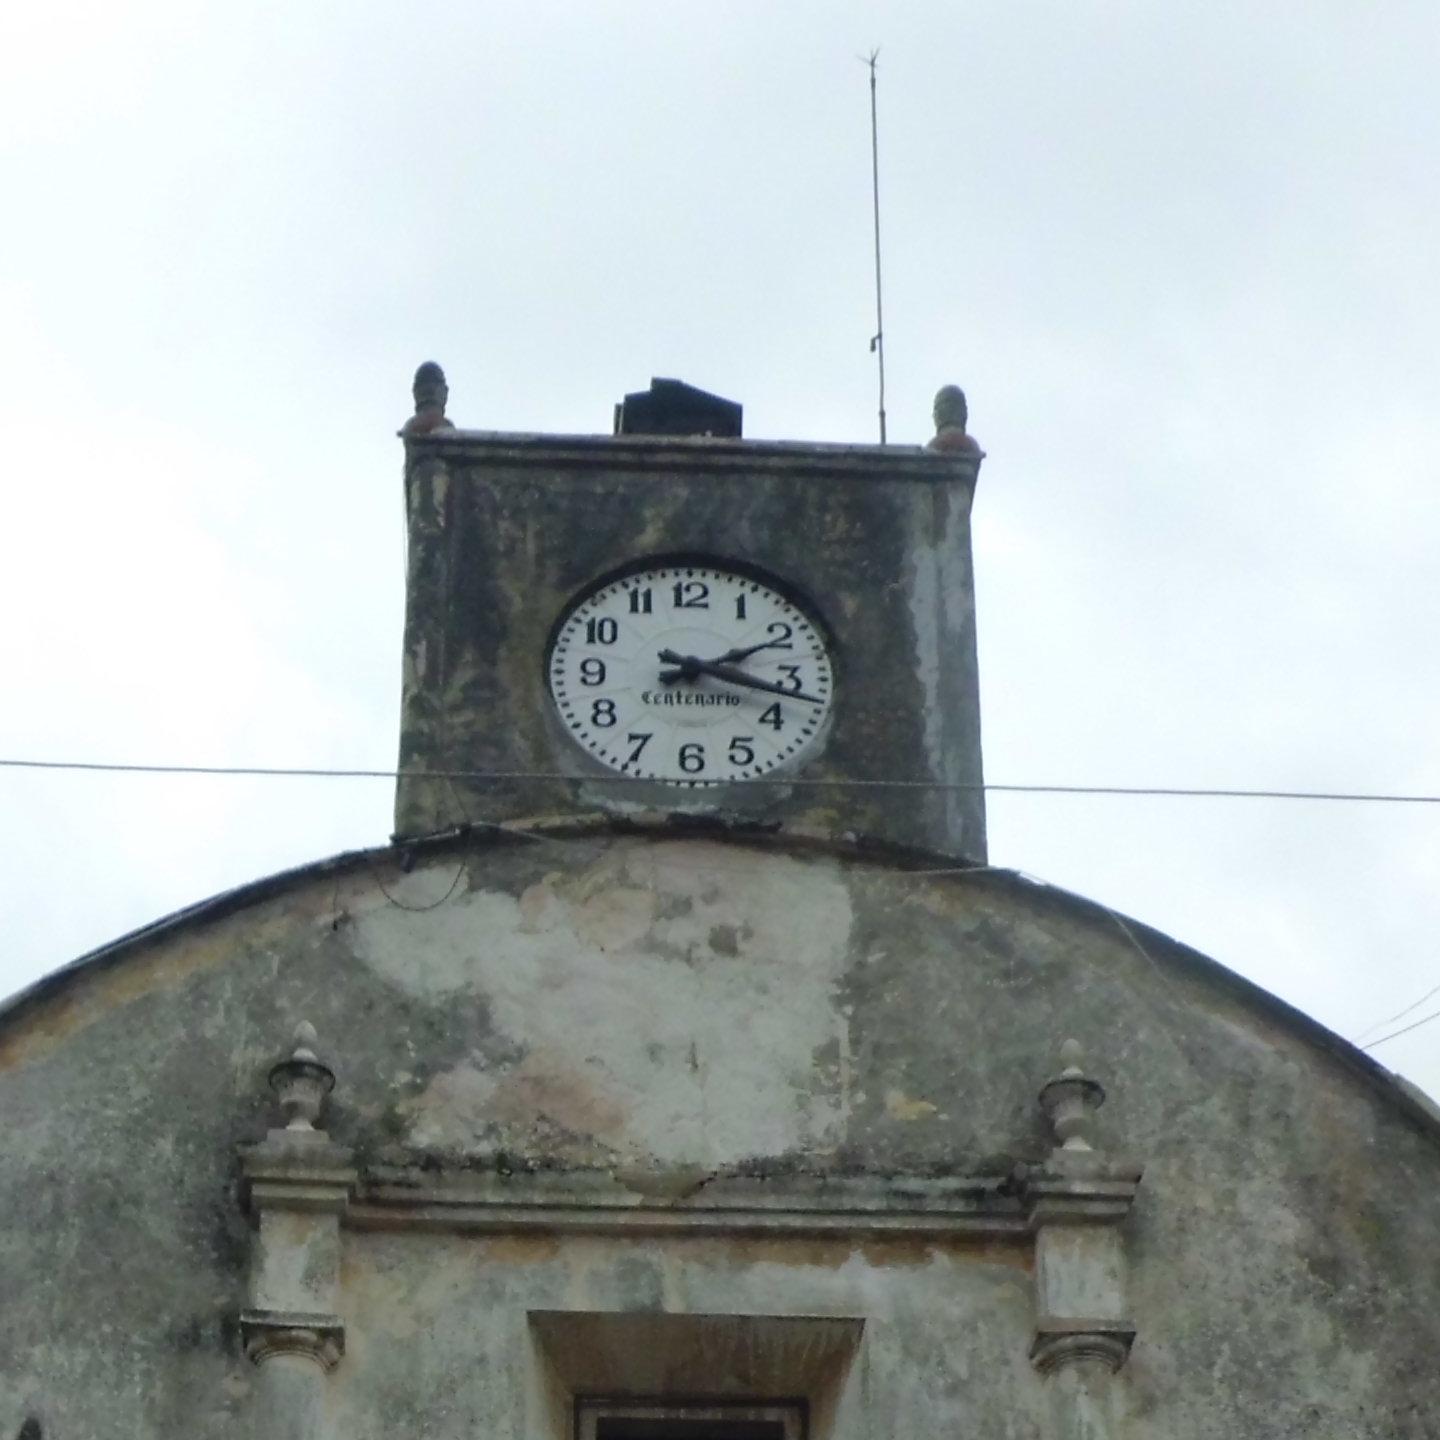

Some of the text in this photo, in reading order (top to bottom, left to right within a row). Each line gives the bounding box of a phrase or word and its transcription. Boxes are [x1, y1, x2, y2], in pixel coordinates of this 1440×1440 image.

[629, 587, 653, 614] 11
[673, 581, 709, 609] 12
[735, 593, 746, 619] 1
[586, 618, 618, 644] 10
[767, 623, 793, 649] 2
[580, 659, 606, 686] 9
[641, 690, 741, 707] Centenario
[592, 699, 617, 727] 8
[758, 703, 784, 730] 4
[628, 733, 653, 762] 7
[679, 743, 705, 773] 6
[729, 737, 755, 765] 5
